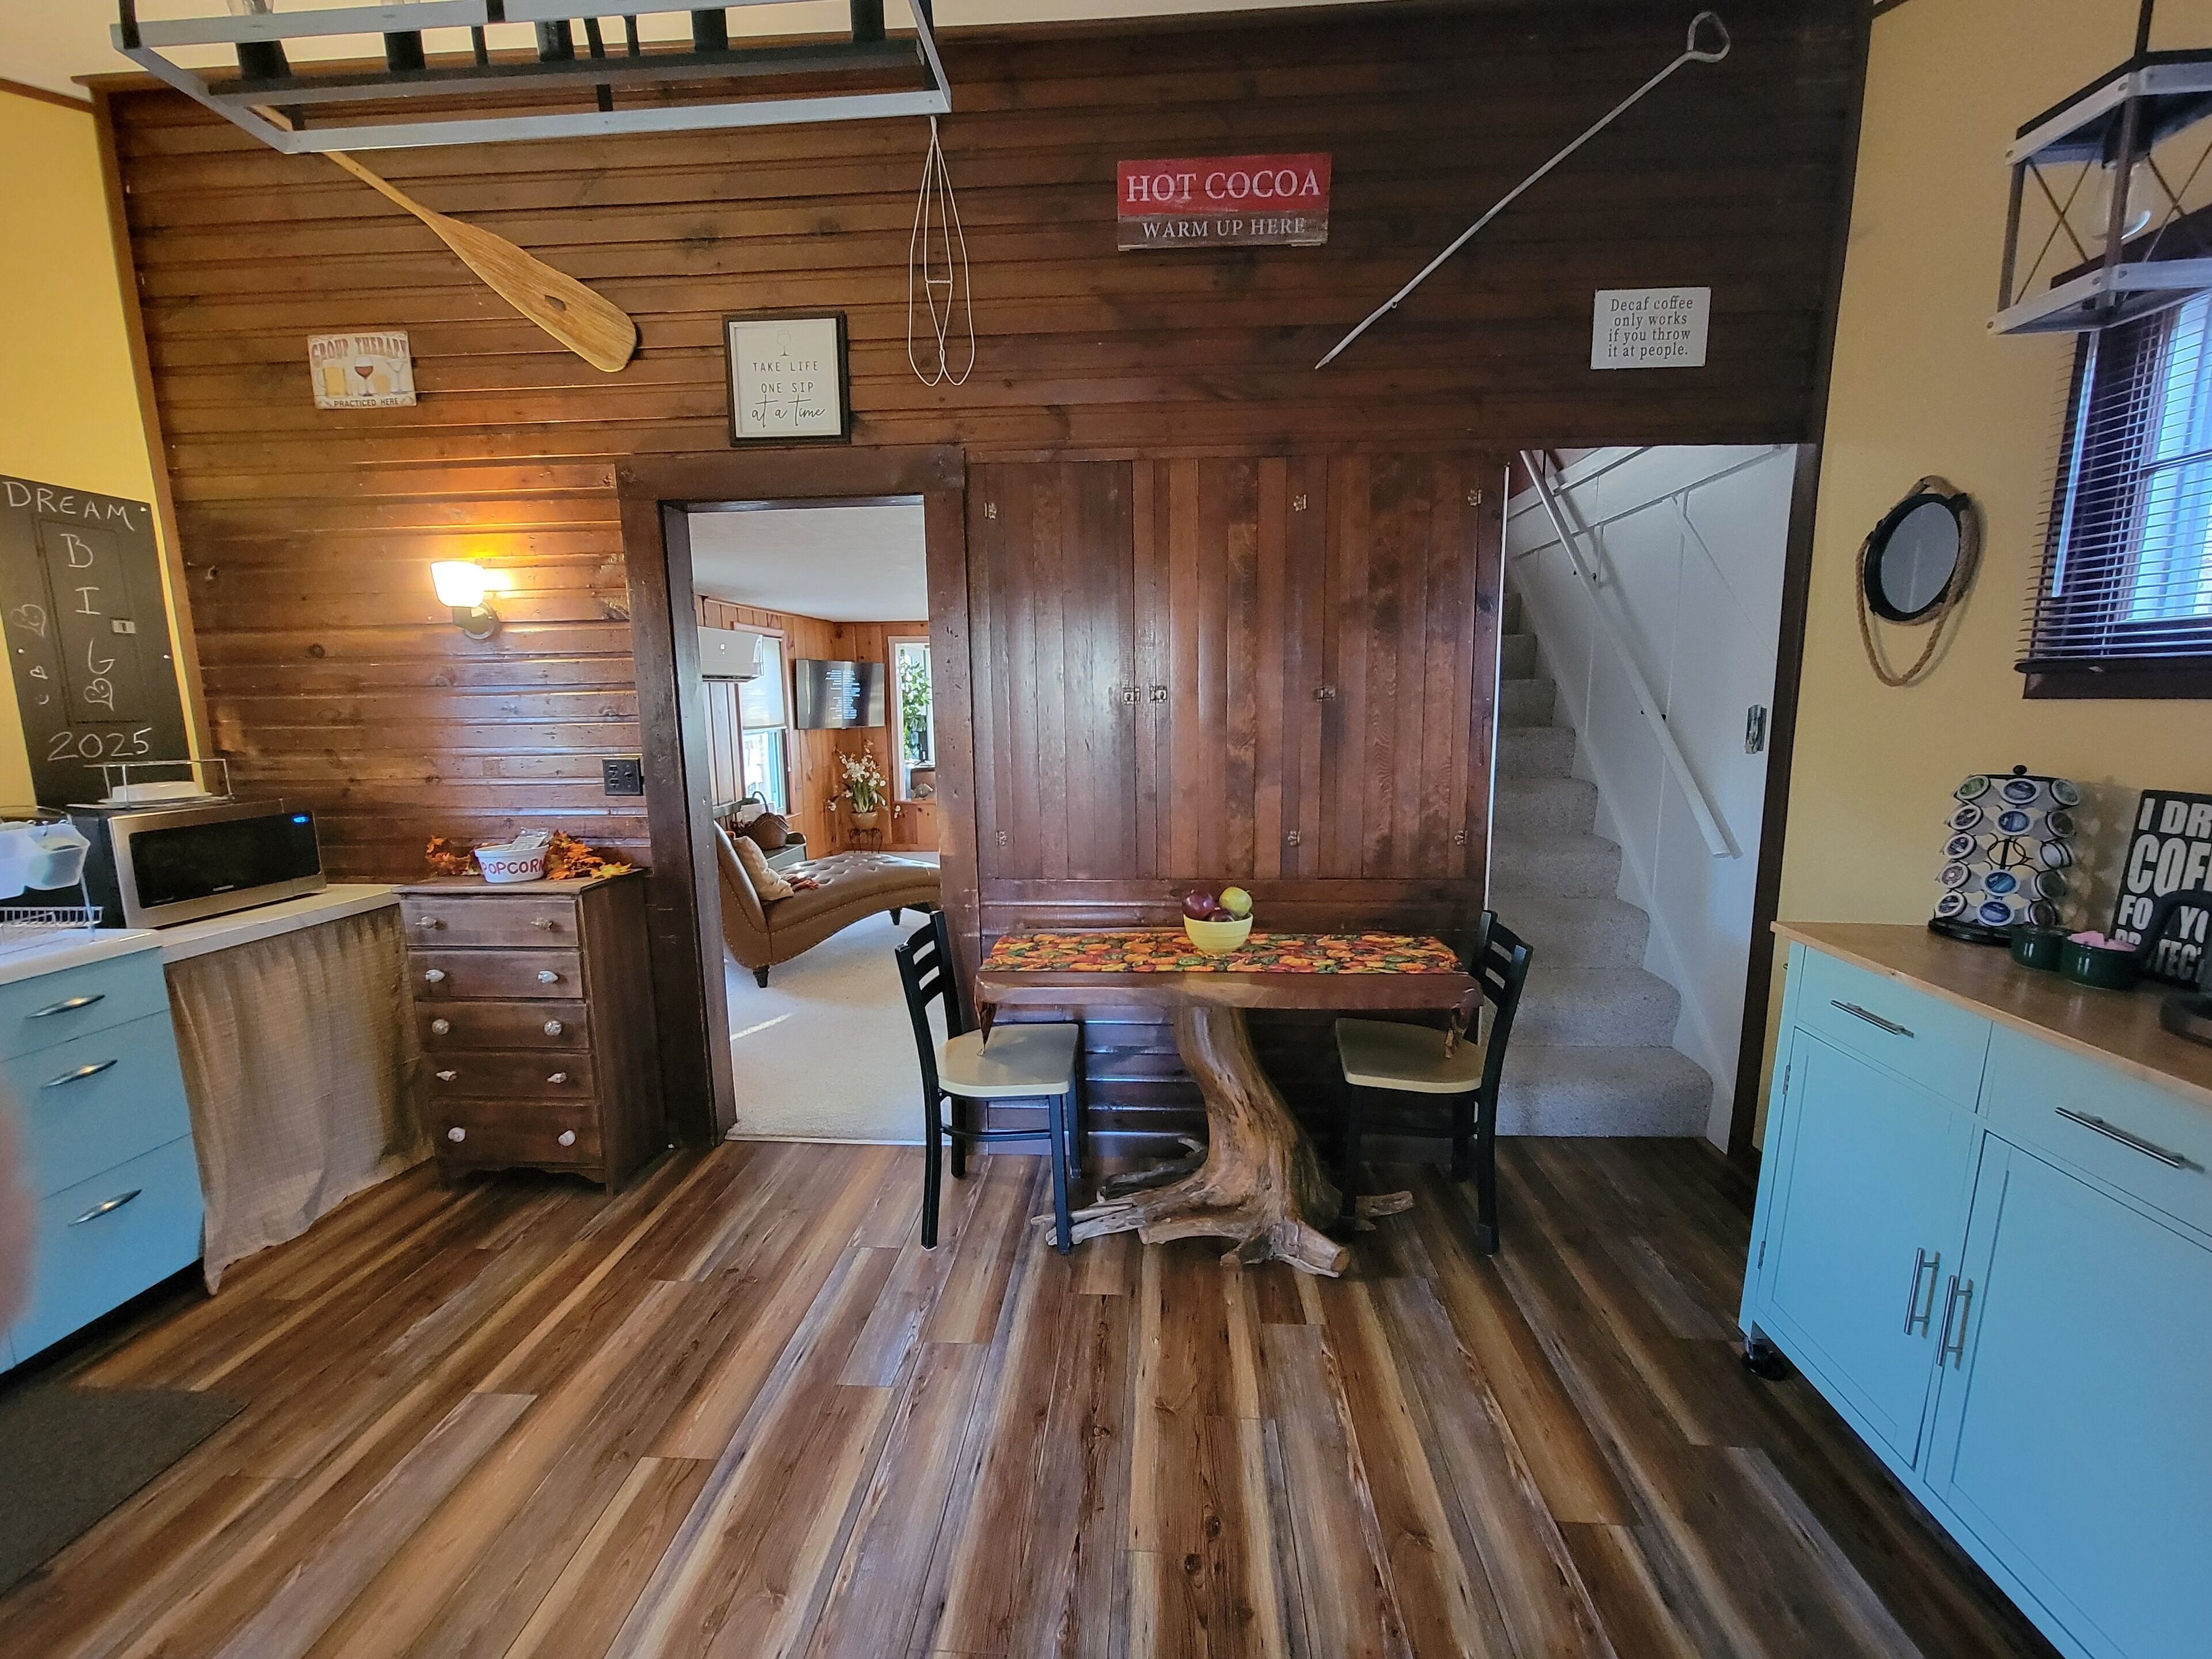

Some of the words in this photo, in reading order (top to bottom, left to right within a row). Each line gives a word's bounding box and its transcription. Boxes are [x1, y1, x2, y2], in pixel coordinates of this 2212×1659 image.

[1126, 173, 1197, 202] HOT
[1205, 169, 1321, 199] COCOA
[1142, 221, 1209, 239] WARM
[1217, 219, 1243, 237] UP
[1251, 217, 1305, 236] HERE
[1610, 296, 1650, 312] Decaf
[1654, 296, 1693, 309] coffee
[1614, 313, 1643, 329] only
[1649, 311, 1687, 325] works
[1608, 328, 1620, 342] if
[1623, 330, 1646, 345] you
[1652, 327, 1691, 341] throw
[312, 338, 349, 368] GROUP
[355, 337, 407, 359] THERAPY
[1608, 344, 1618, 357] it
[1623, 345, 1635, 357] at
[1639, 342, 1688, 360] people.
[752, 361, 781, 372] TAKE
[790, 361, 819, 372] LIFE
[761, 382, 783, 393] ONE
[791, 382, 814, 393] SIP
[334, 399, 377, 407] PRACTICED
[380, 397, 399, 406] HERE
[752, 394, 779, 428] at
[775, 408, 788, 419] a
[787, 395, 825, 426] time
[2, 482, 135, 532] DREAM
[60, 533, 115, 675] BIG
[47, 728, 153, 761] 2025
[2138, 797, 2156, 831] I
[2159, 800, 2212, 839] DR
[2118, 894, 2154, 930] FO
